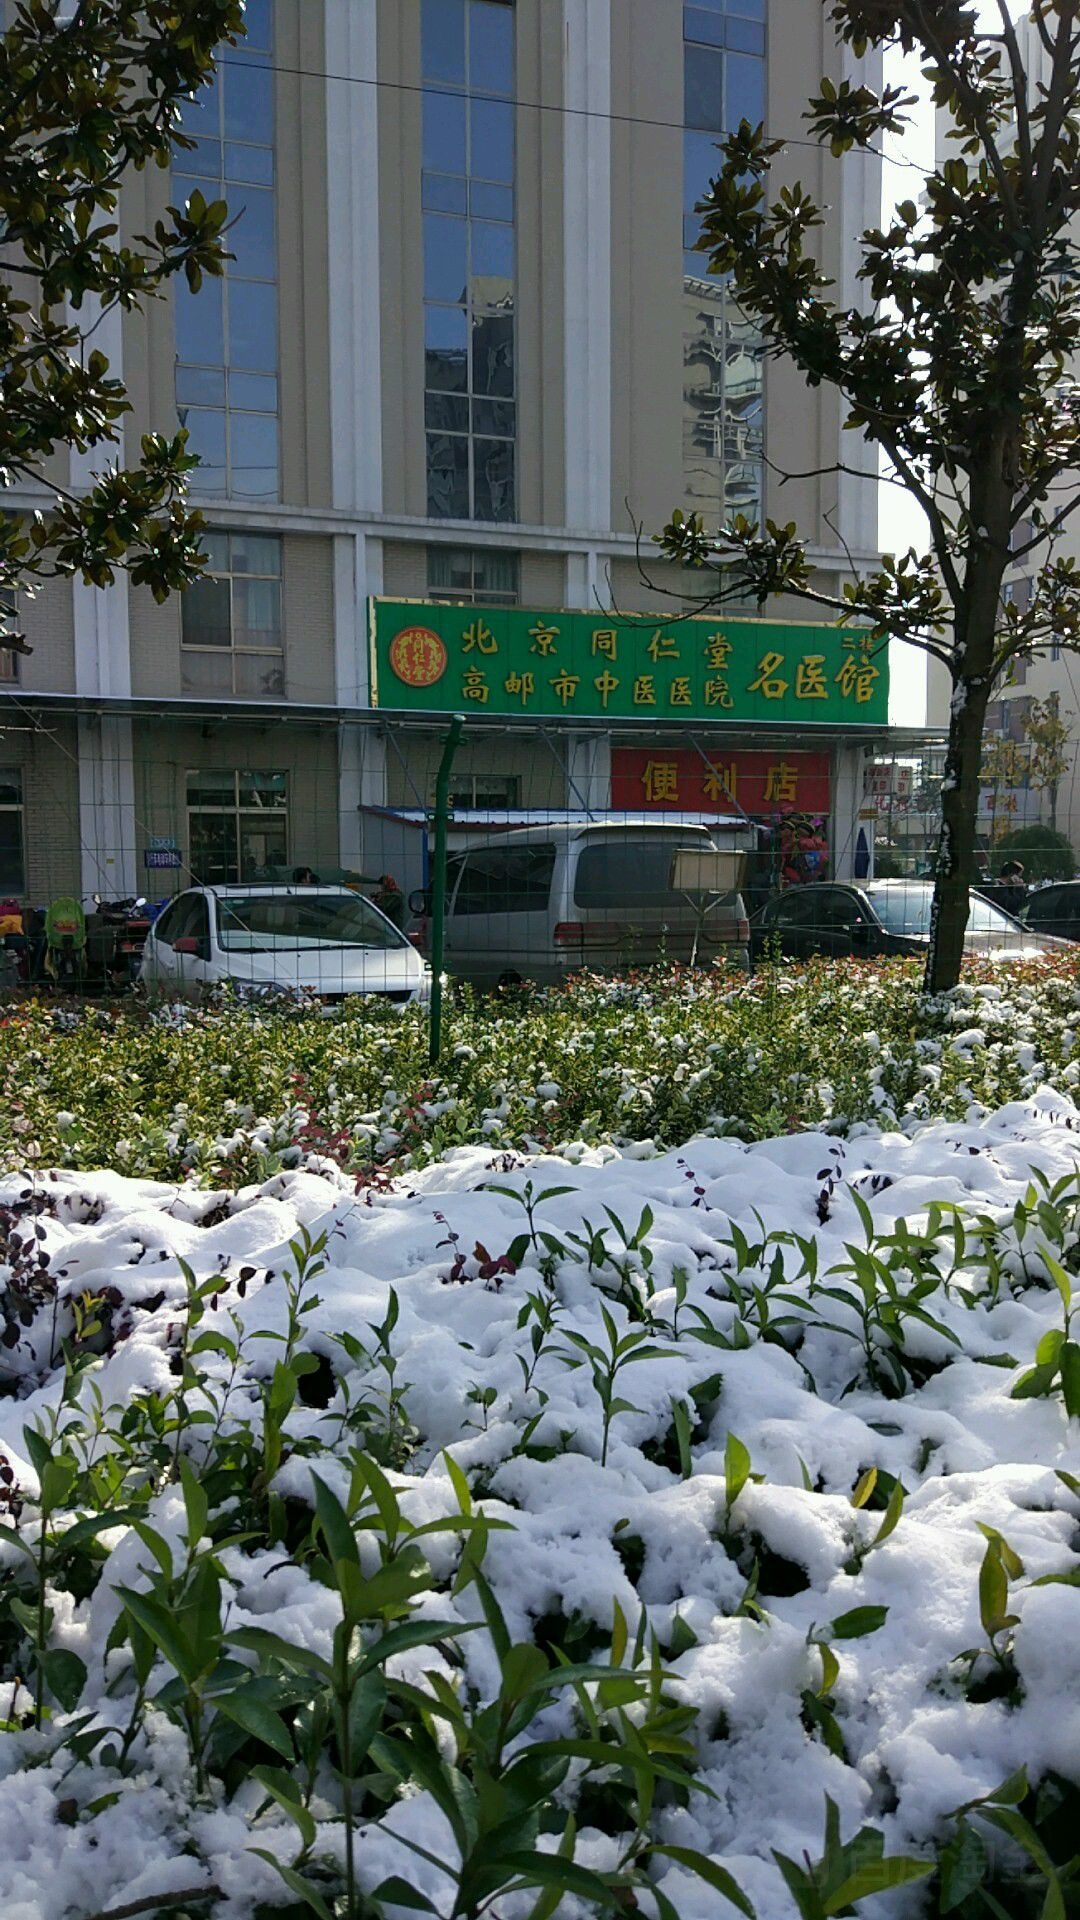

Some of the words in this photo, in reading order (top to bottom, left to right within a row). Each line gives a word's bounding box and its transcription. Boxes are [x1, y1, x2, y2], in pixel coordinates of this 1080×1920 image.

[462, 618, 734, 671] 北京同仁堂
[461, 666, 735, 709] 高邮市中医医院
[747, 652, 879, 703] 名医馆
[641, 760, 799, 803] 便利店
